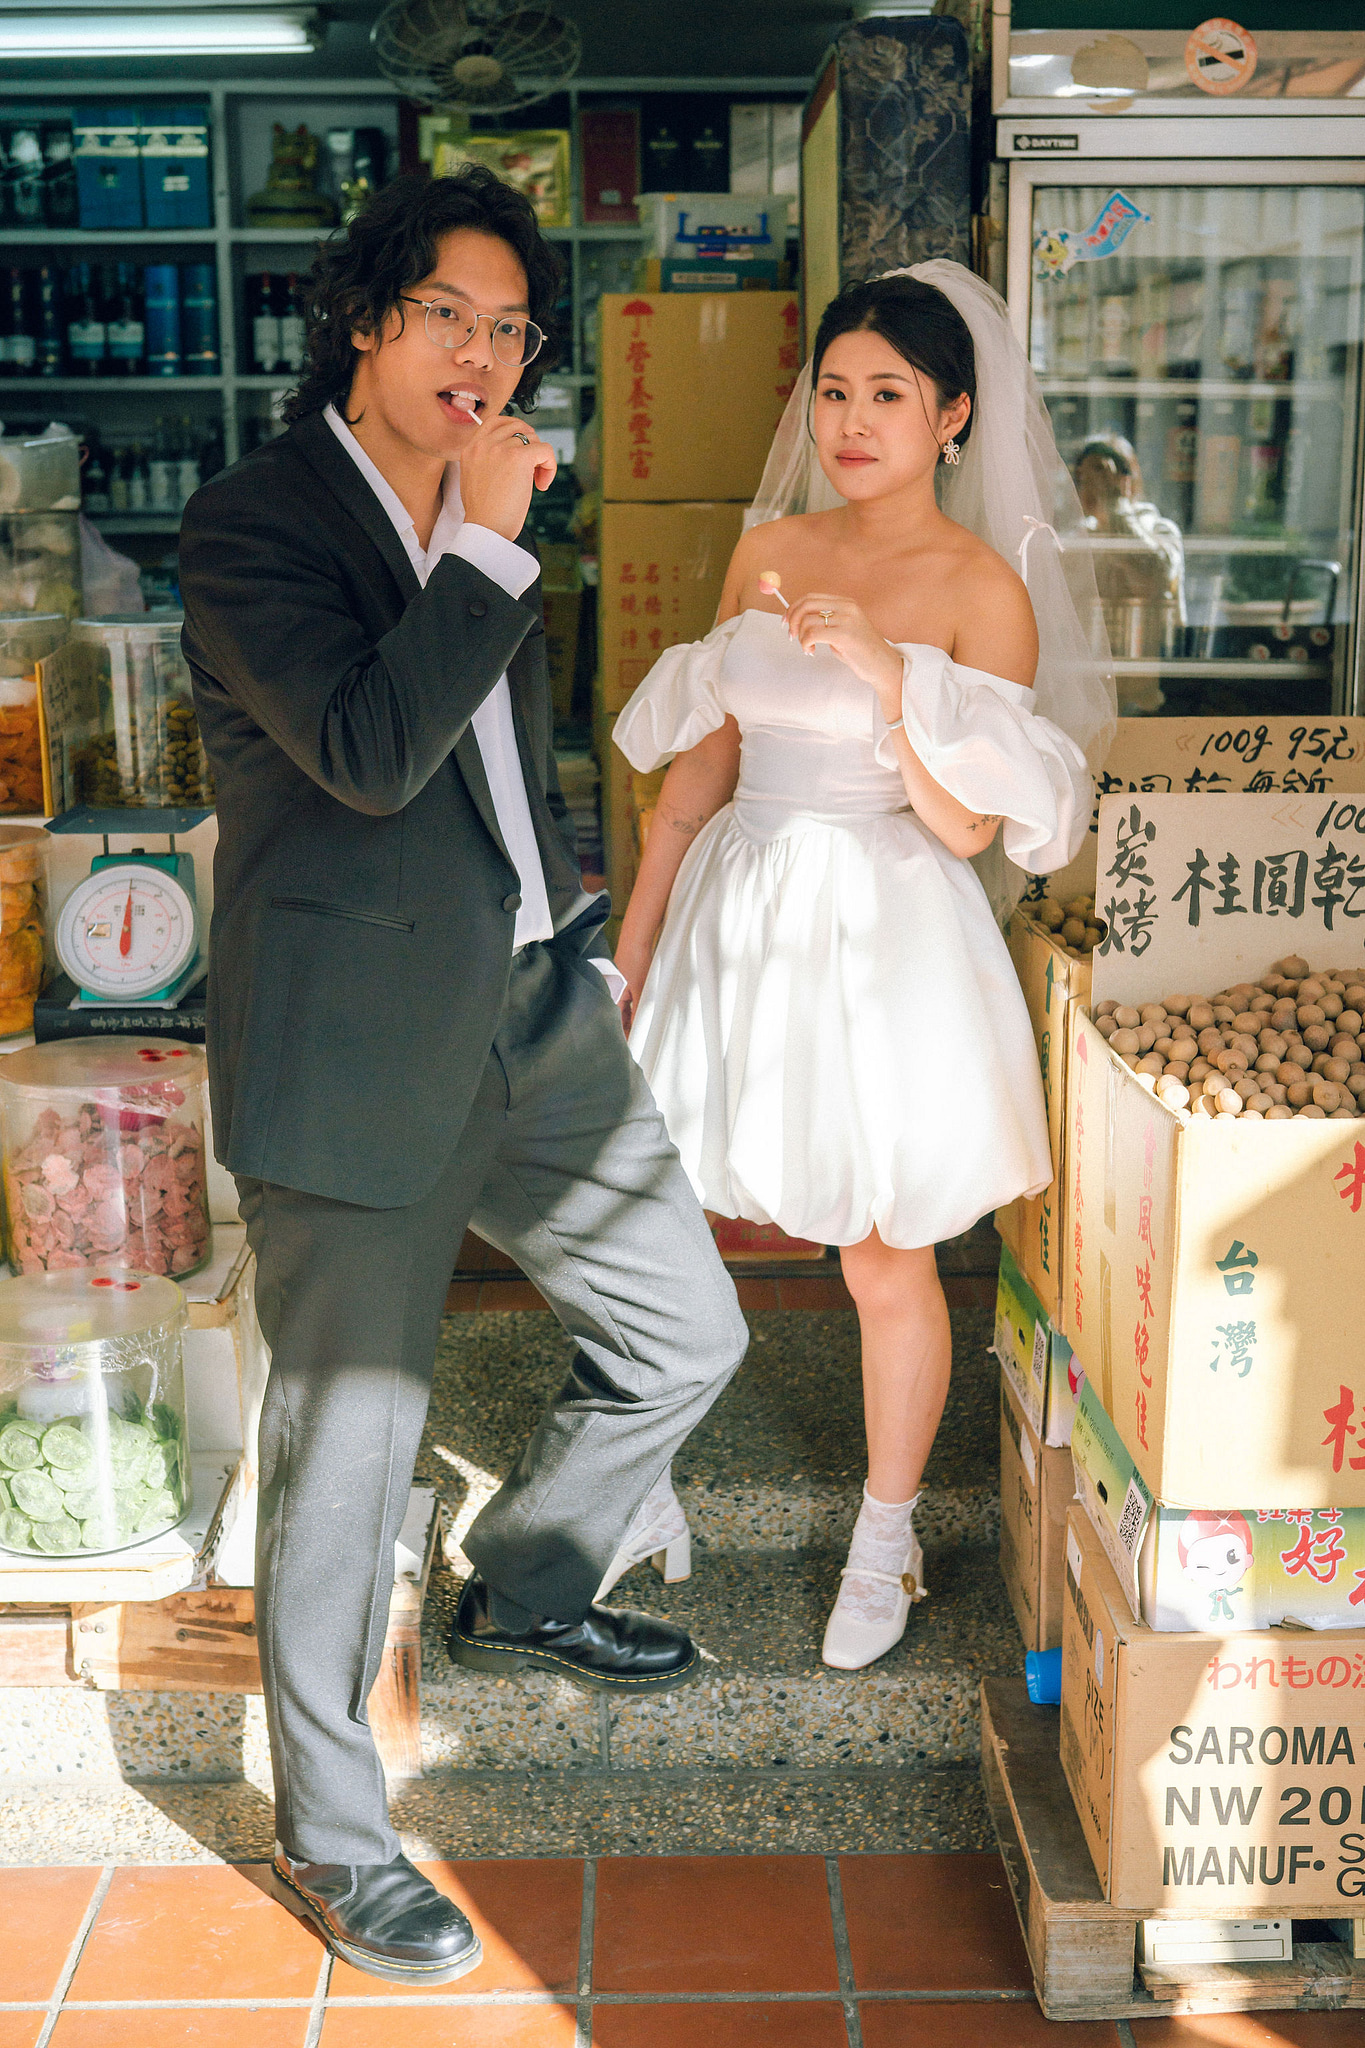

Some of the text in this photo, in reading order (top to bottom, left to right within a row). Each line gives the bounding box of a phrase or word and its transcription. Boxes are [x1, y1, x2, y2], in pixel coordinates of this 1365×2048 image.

[1199, 724, 1273, 763] 100g
[1098, 803, 1159, 957] 炭烤
[1171, 840, 1365, 931] 桂圓乾
[1134, 1195, 1156, 1452] 風味絕佳
[1209, 1239, 1259, 1378] 台灣
[1168, 1724, 1357, 1766] SAROMA
[1164, 1785, 1263, 1826] NW
